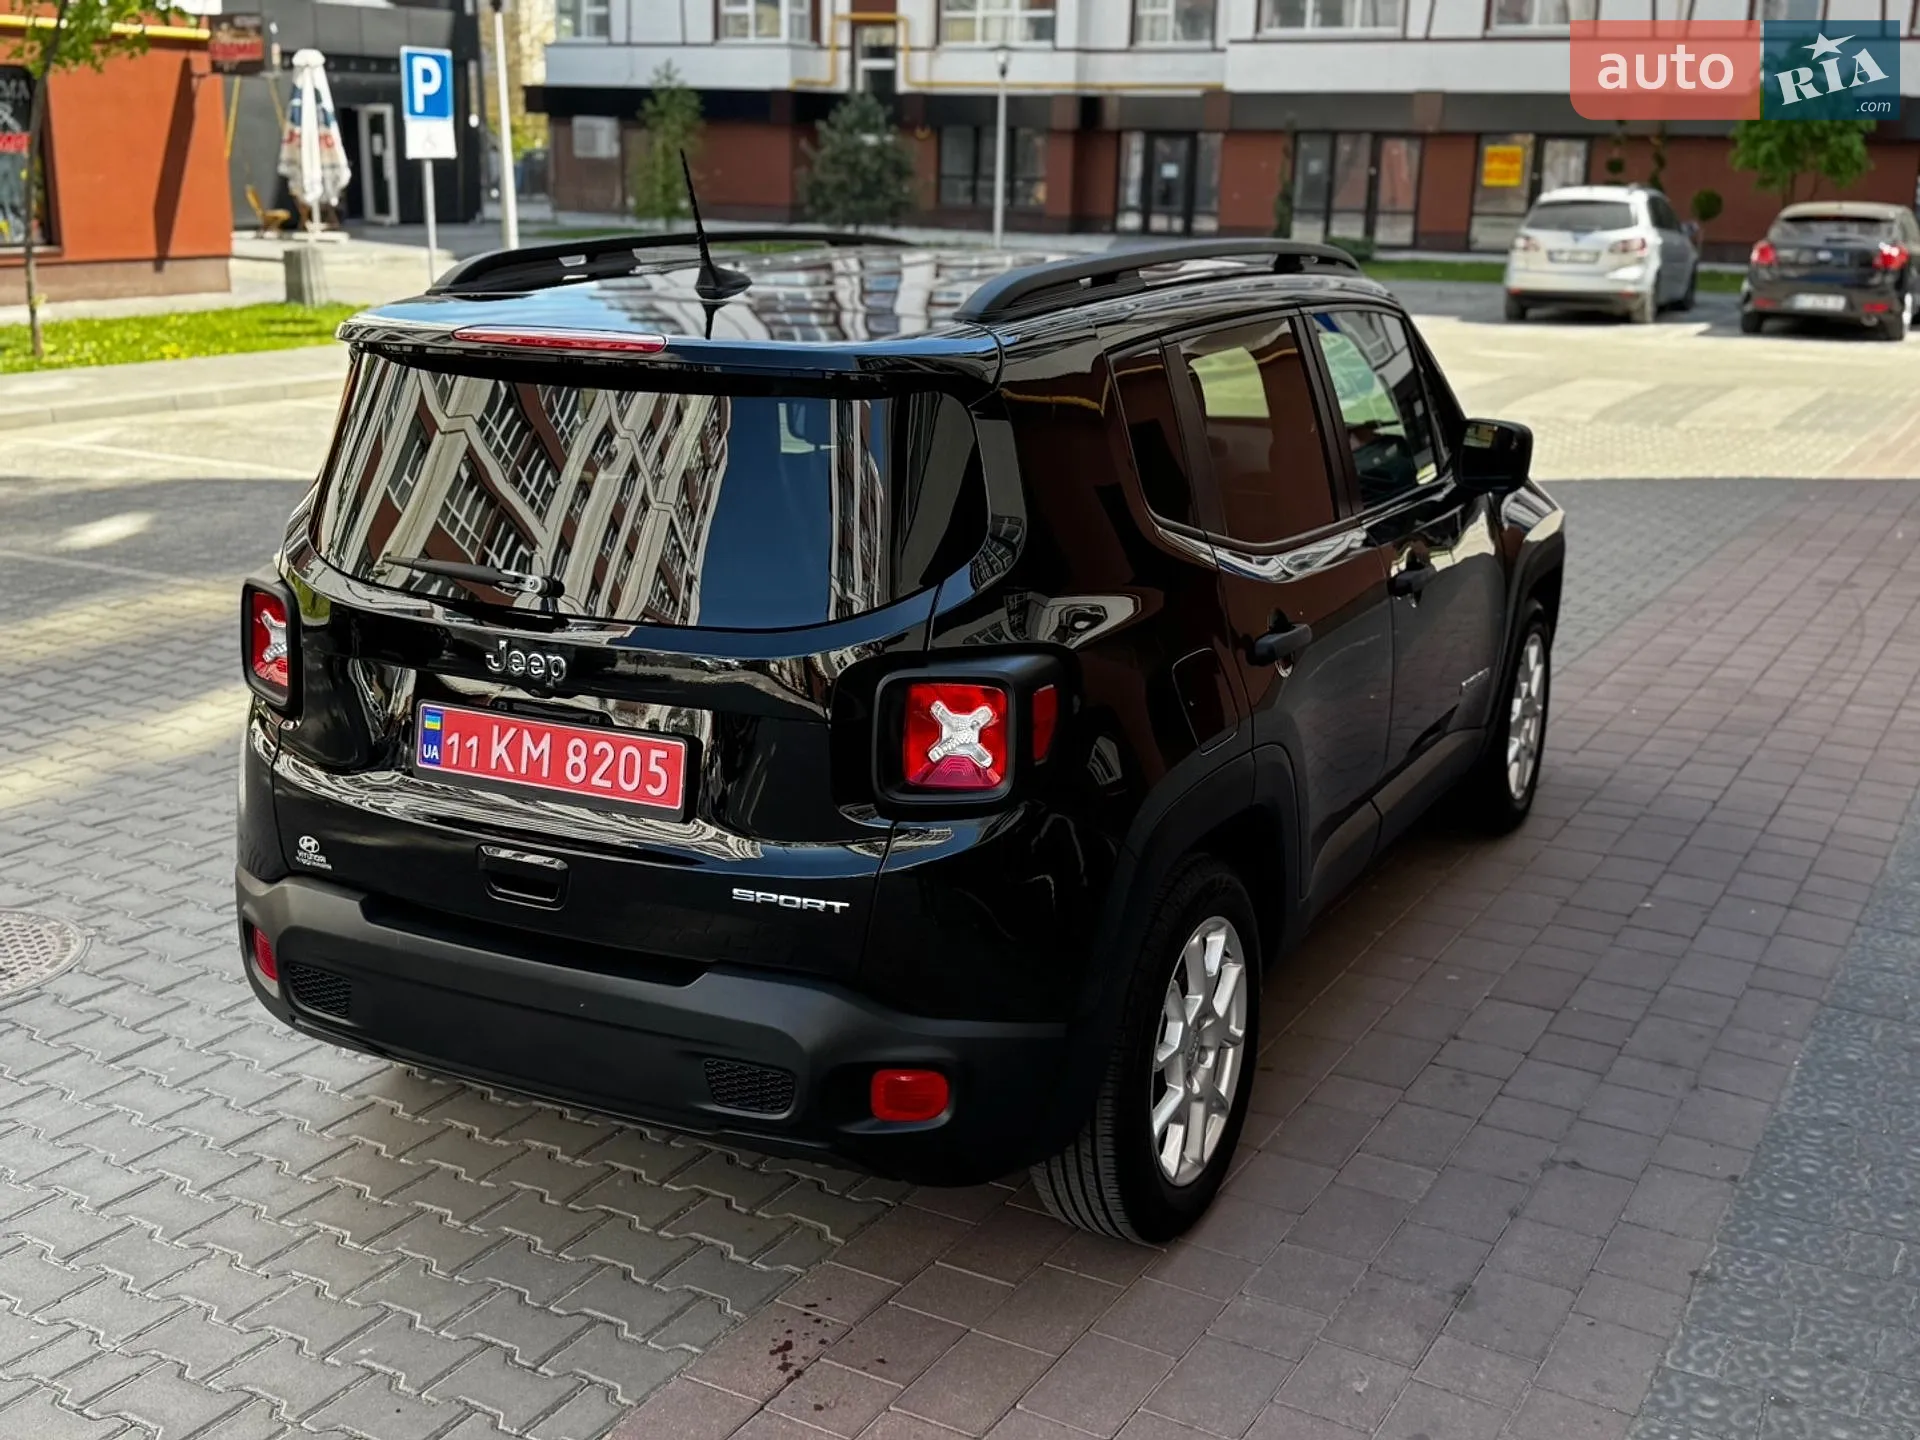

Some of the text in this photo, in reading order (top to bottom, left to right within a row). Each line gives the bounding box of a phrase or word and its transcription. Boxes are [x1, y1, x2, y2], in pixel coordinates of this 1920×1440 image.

[412, 55, 442, 113] P
[485, 640, 566, 687] Jeep
[422, 744, 439, 760] UA
[446, 724, 668, 797] 11 KM 8205
[732, 887, 850, 914] SPORT
